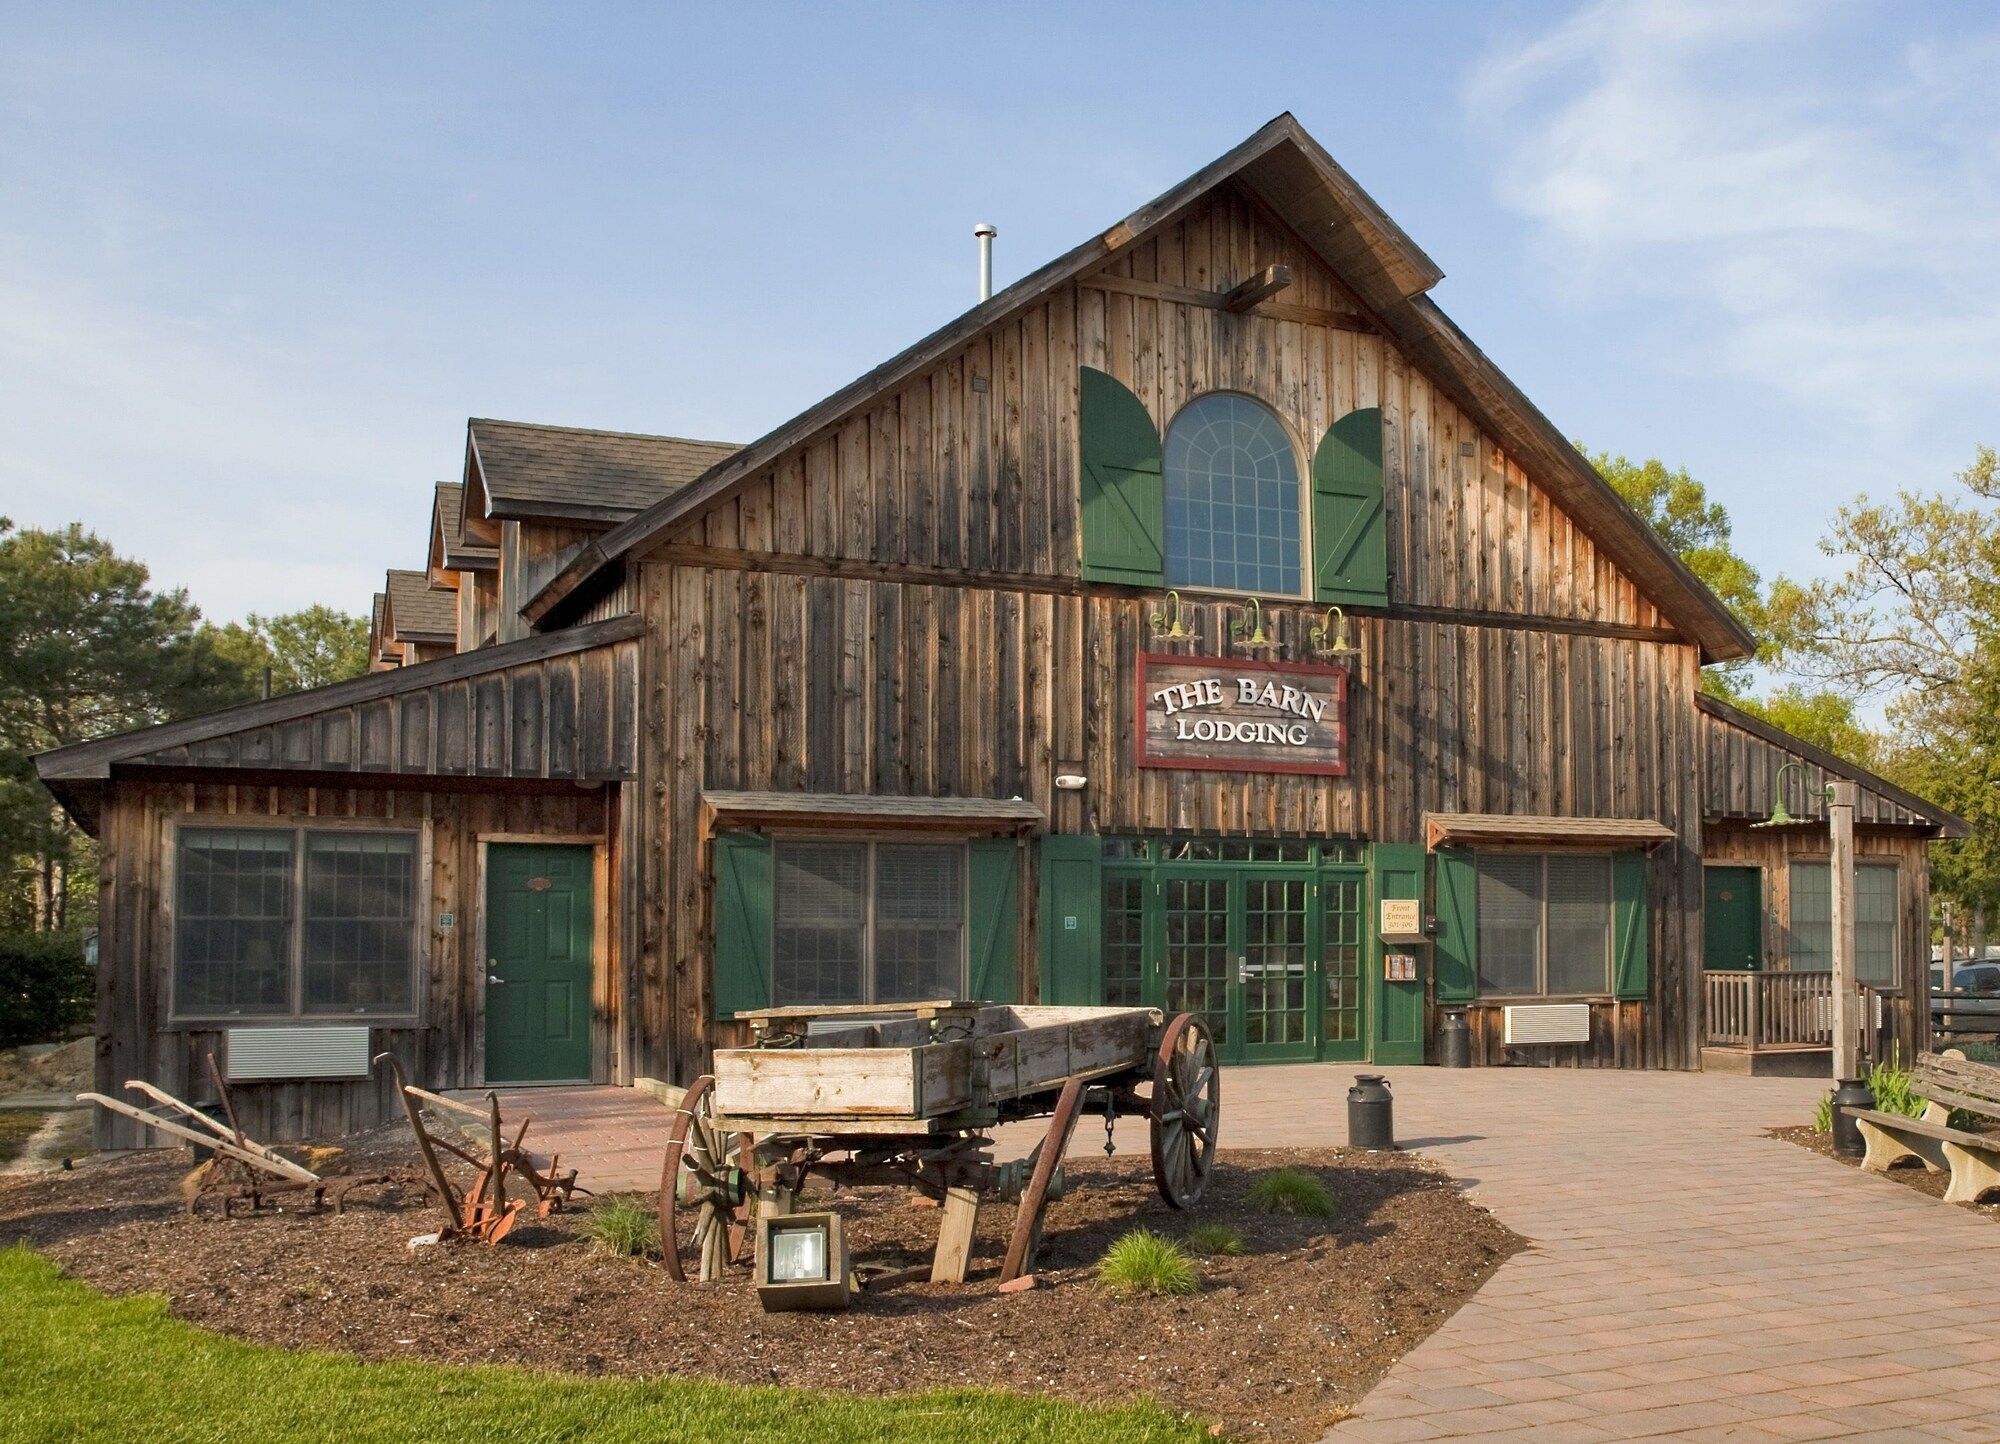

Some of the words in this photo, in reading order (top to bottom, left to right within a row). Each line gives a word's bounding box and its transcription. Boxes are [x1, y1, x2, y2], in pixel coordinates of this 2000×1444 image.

[1154, 679, 1224, 715] THE
[1236, 678, 1328, 723] BARN
[1176, 718, 1309, 746] LODGING
[1386, 912, 1416, 920] Entrance
